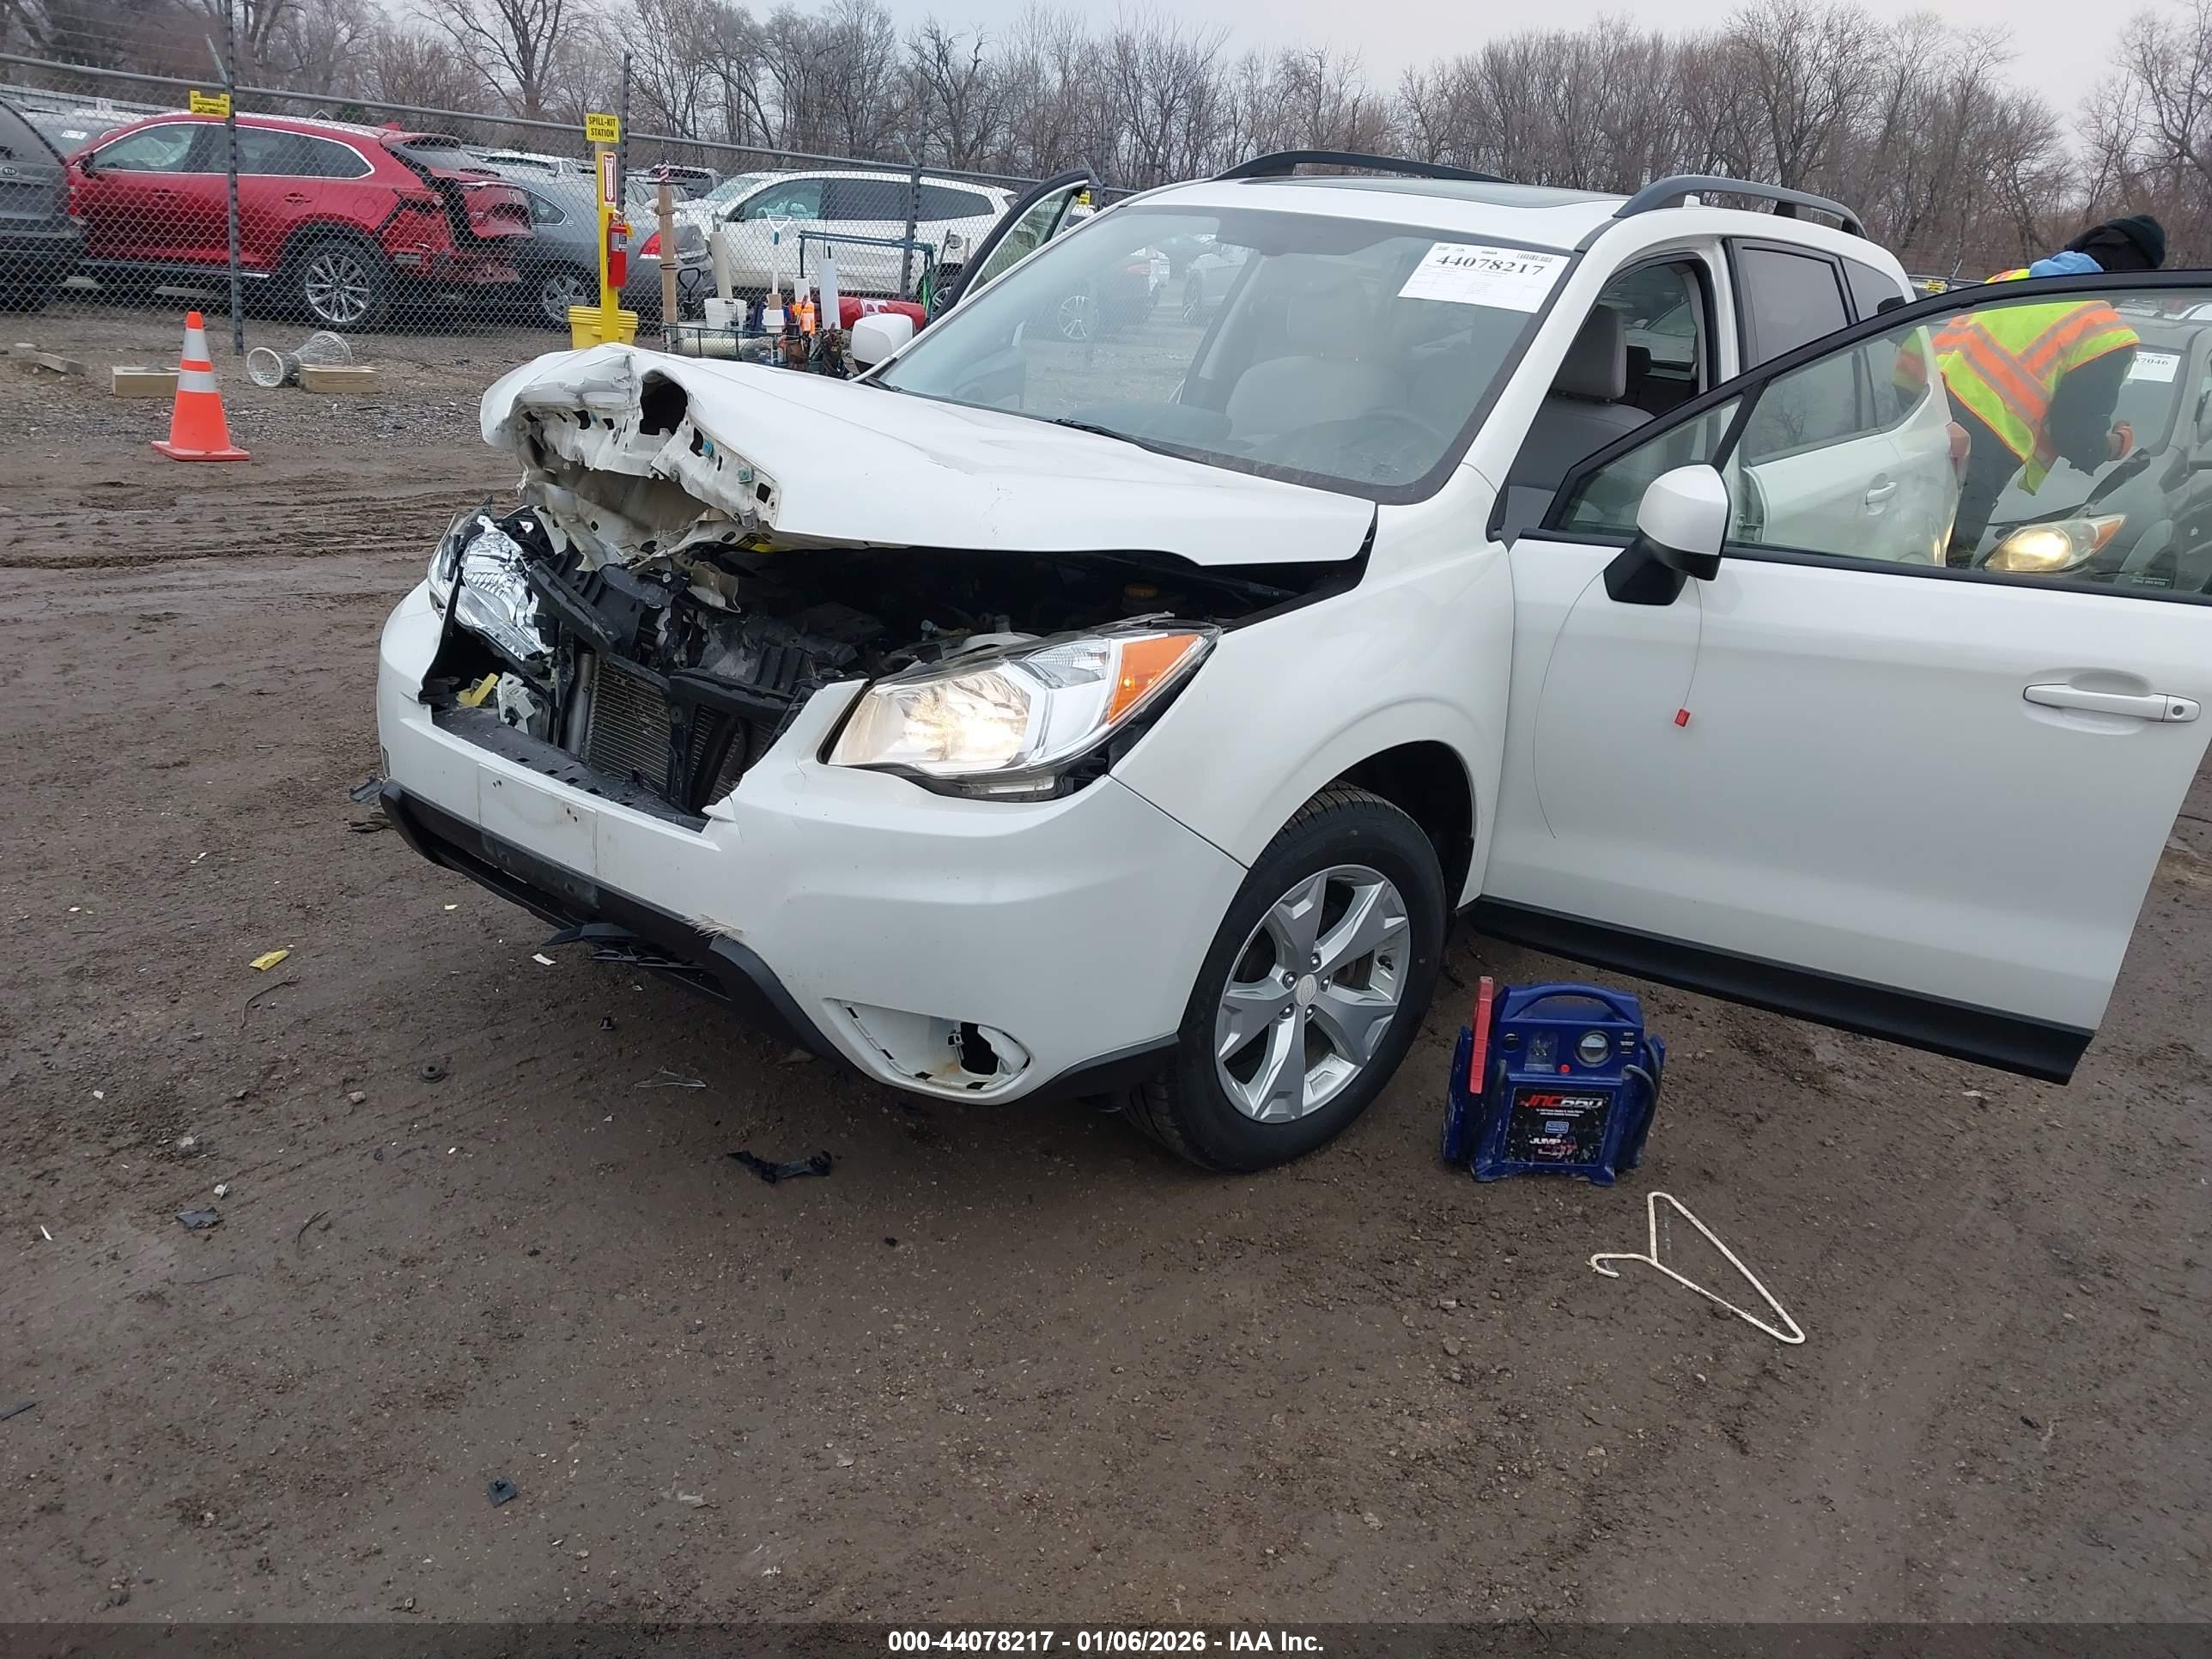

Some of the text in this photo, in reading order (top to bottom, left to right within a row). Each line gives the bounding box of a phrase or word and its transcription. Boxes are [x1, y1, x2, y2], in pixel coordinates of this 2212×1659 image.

[588, 117, 617, 127] SPILL-KIT
[590, 127, 615, 137] STATION
[1436, 254, 1546, 276] 44078217
